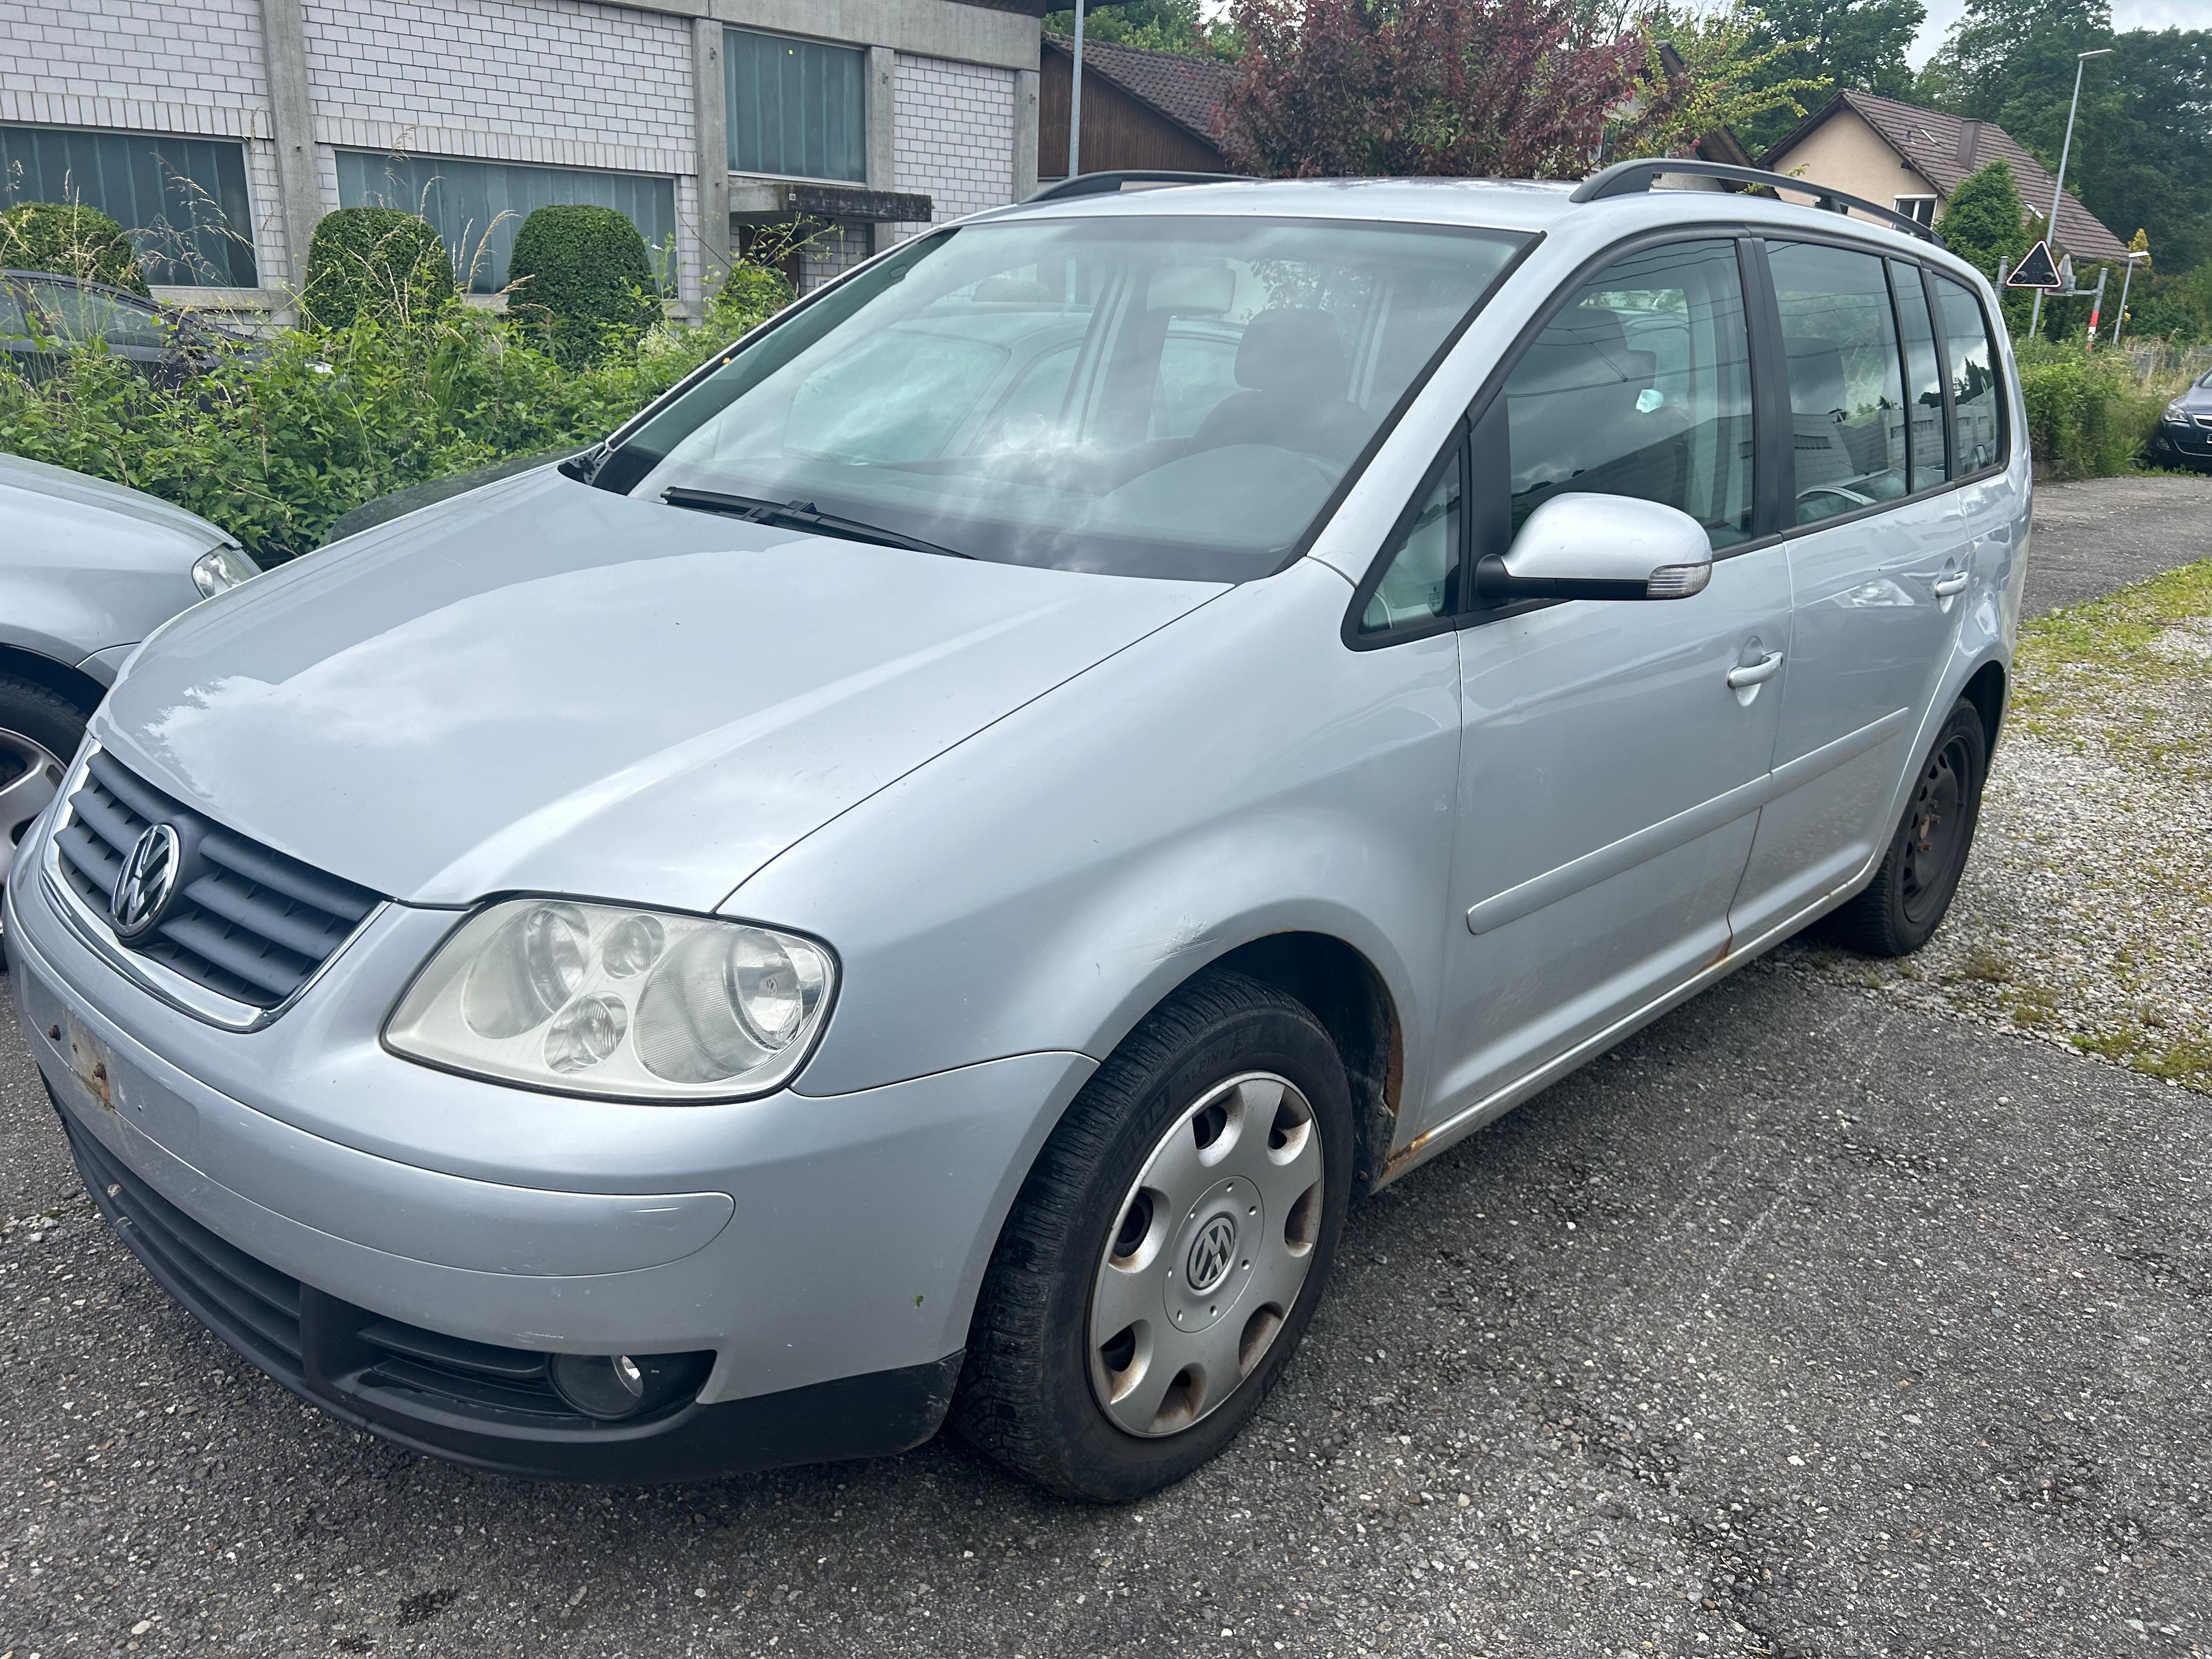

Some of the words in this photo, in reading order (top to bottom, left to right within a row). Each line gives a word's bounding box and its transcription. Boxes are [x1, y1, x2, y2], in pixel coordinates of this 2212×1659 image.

[113, 825, 176, 932] VW
[1090, 1094, 1166, 1224] CHELIN
[1190, 1219, 1234, 1286] VW
